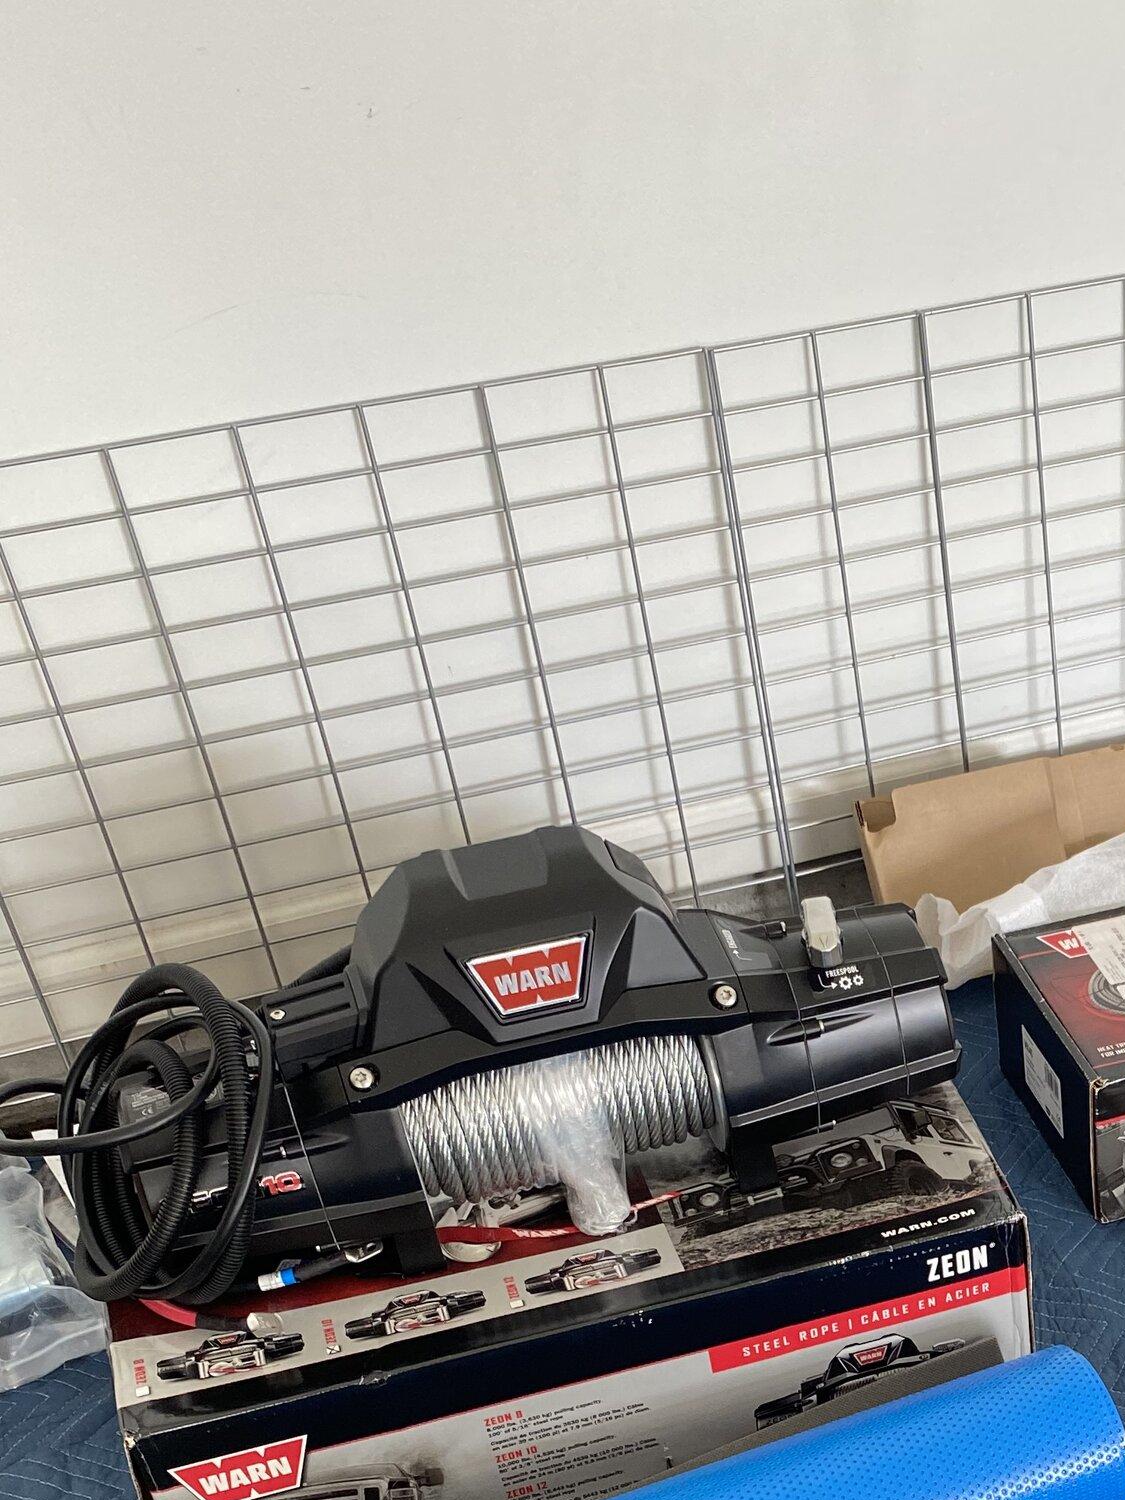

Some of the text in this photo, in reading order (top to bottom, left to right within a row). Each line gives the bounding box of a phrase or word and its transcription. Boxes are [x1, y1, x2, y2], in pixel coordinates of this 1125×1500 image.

[494, 961, 572, 996] WARN
[825, 965, 859, 979] FREESPOOL
[1097, 1043, 1115, 1053] HEAT
[1100, 1050, 1115, 1059] FOR
[880, 1208, 976, 1239] WARN.COM
[742, 1282, 991, 1358] STEEL ROPE CÂBLE EN ACIER
[484, 1413, 512, 1426] ZEON
[495, 1445, 537, 1462] ZEON 10
[198, 1456, 292, 1495] WARN
[506, 1485, 533, 1498] ZEON
